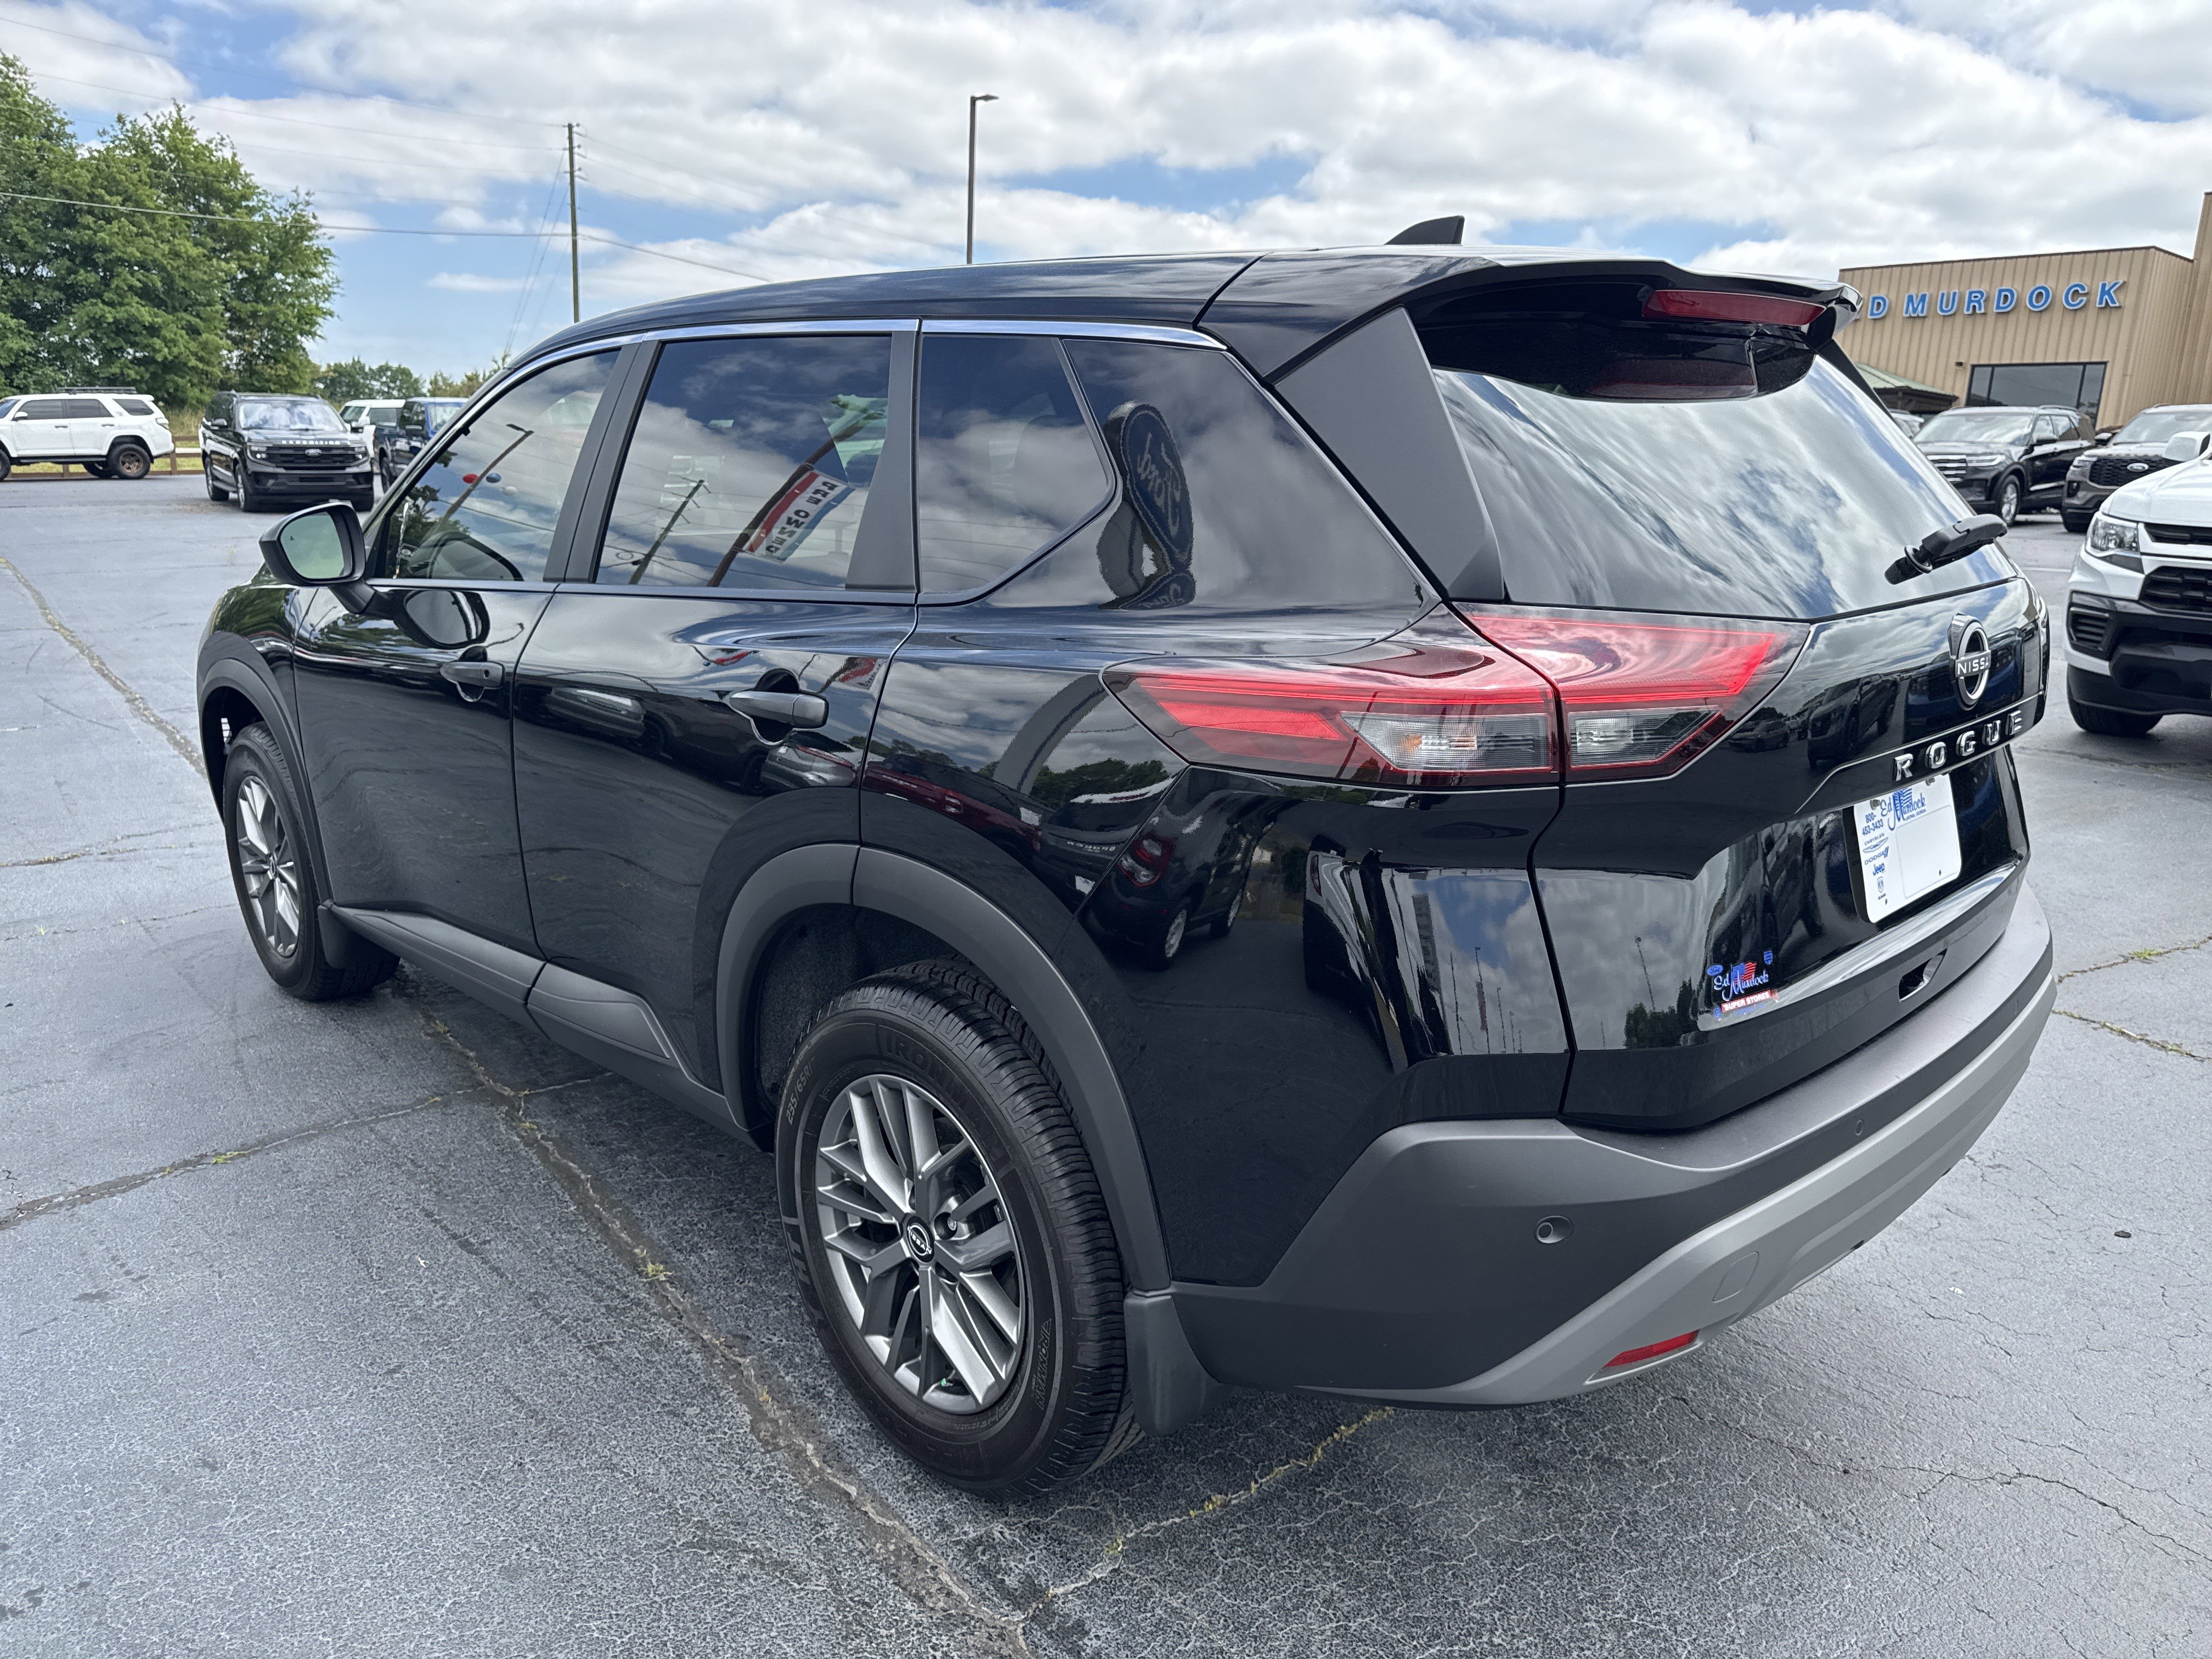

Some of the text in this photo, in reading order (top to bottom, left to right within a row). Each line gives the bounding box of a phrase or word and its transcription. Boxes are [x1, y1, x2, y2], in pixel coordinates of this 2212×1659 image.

[1867, 280, 2126, 319] D MURDOCK
[1957, 656, 1990, 675] NISSA
[1894, 710, 2022, 782] ROGUE
[1880, 797, 1892, 817] Ed
[1865, 812, 1876, 823] 800-
[1862, 819, 1883, 836] 453-3433
[1864, 833, 1884, 845] CHRYSLER
[1864, 850, 1886, 865] DODGE
[1873, 862, 1885, 876] Jeep
[1713, 969, 1769, 1001] Ed Murdock
[1723, 998, 1746, 1011] SUPER
[1746, 991, 1770, 1005] STORES
